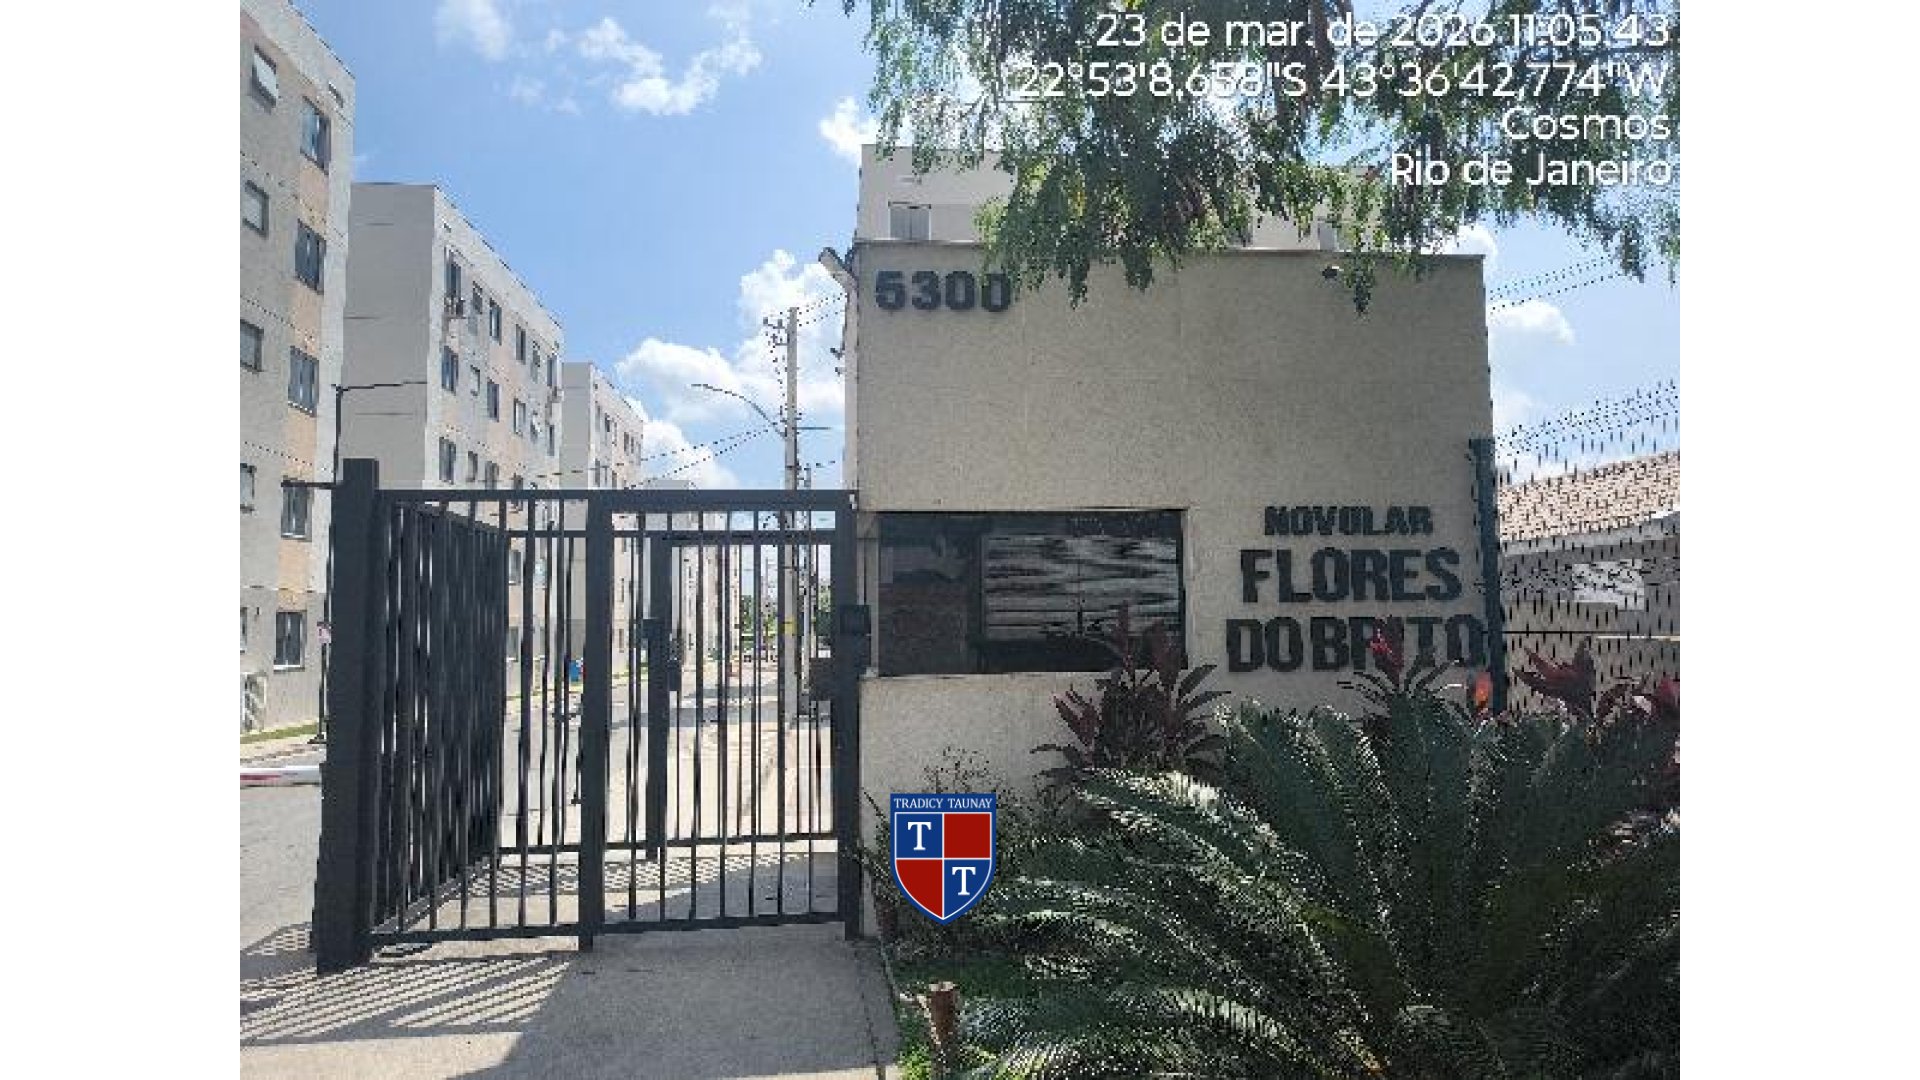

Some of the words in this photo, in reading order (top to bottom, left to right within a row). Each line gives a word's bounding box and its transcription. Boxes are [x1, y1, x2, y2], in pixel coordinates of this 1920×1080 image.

[875, 270, 1011, 312] 5300
[1264, 505, 1433, 536] NOVOLAR
[1240, 547, 1462, 602] FLORES
[1226, 617, 1303, 673] DO
